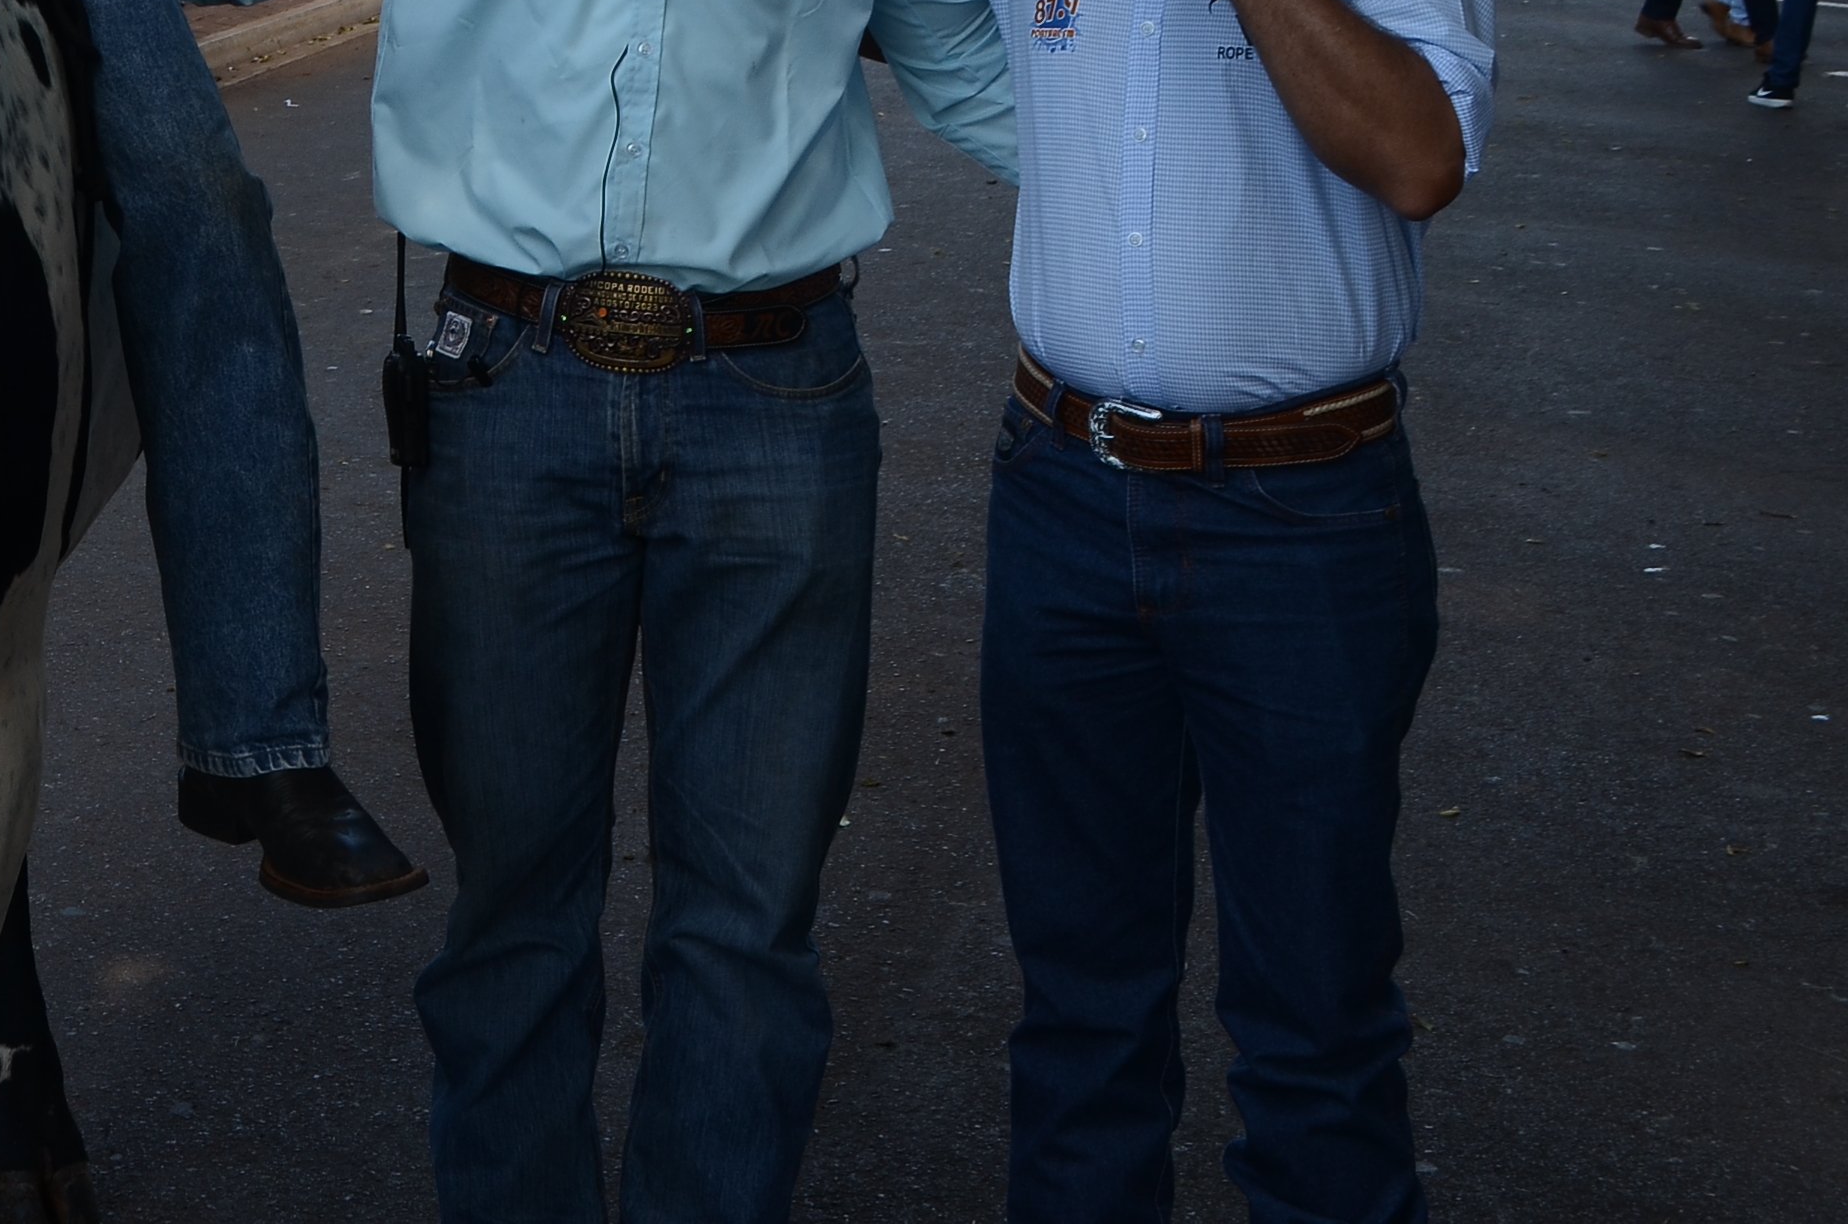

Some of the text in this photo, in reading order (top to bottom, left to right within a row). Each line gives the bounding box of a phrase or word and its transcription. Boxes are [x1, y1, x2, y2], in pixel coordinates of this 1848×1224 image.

[1217, 47, 1254, 60] ROPE
[597, 281, 625, 293] COPA
[627, 284, 666, 295] RODEIO
